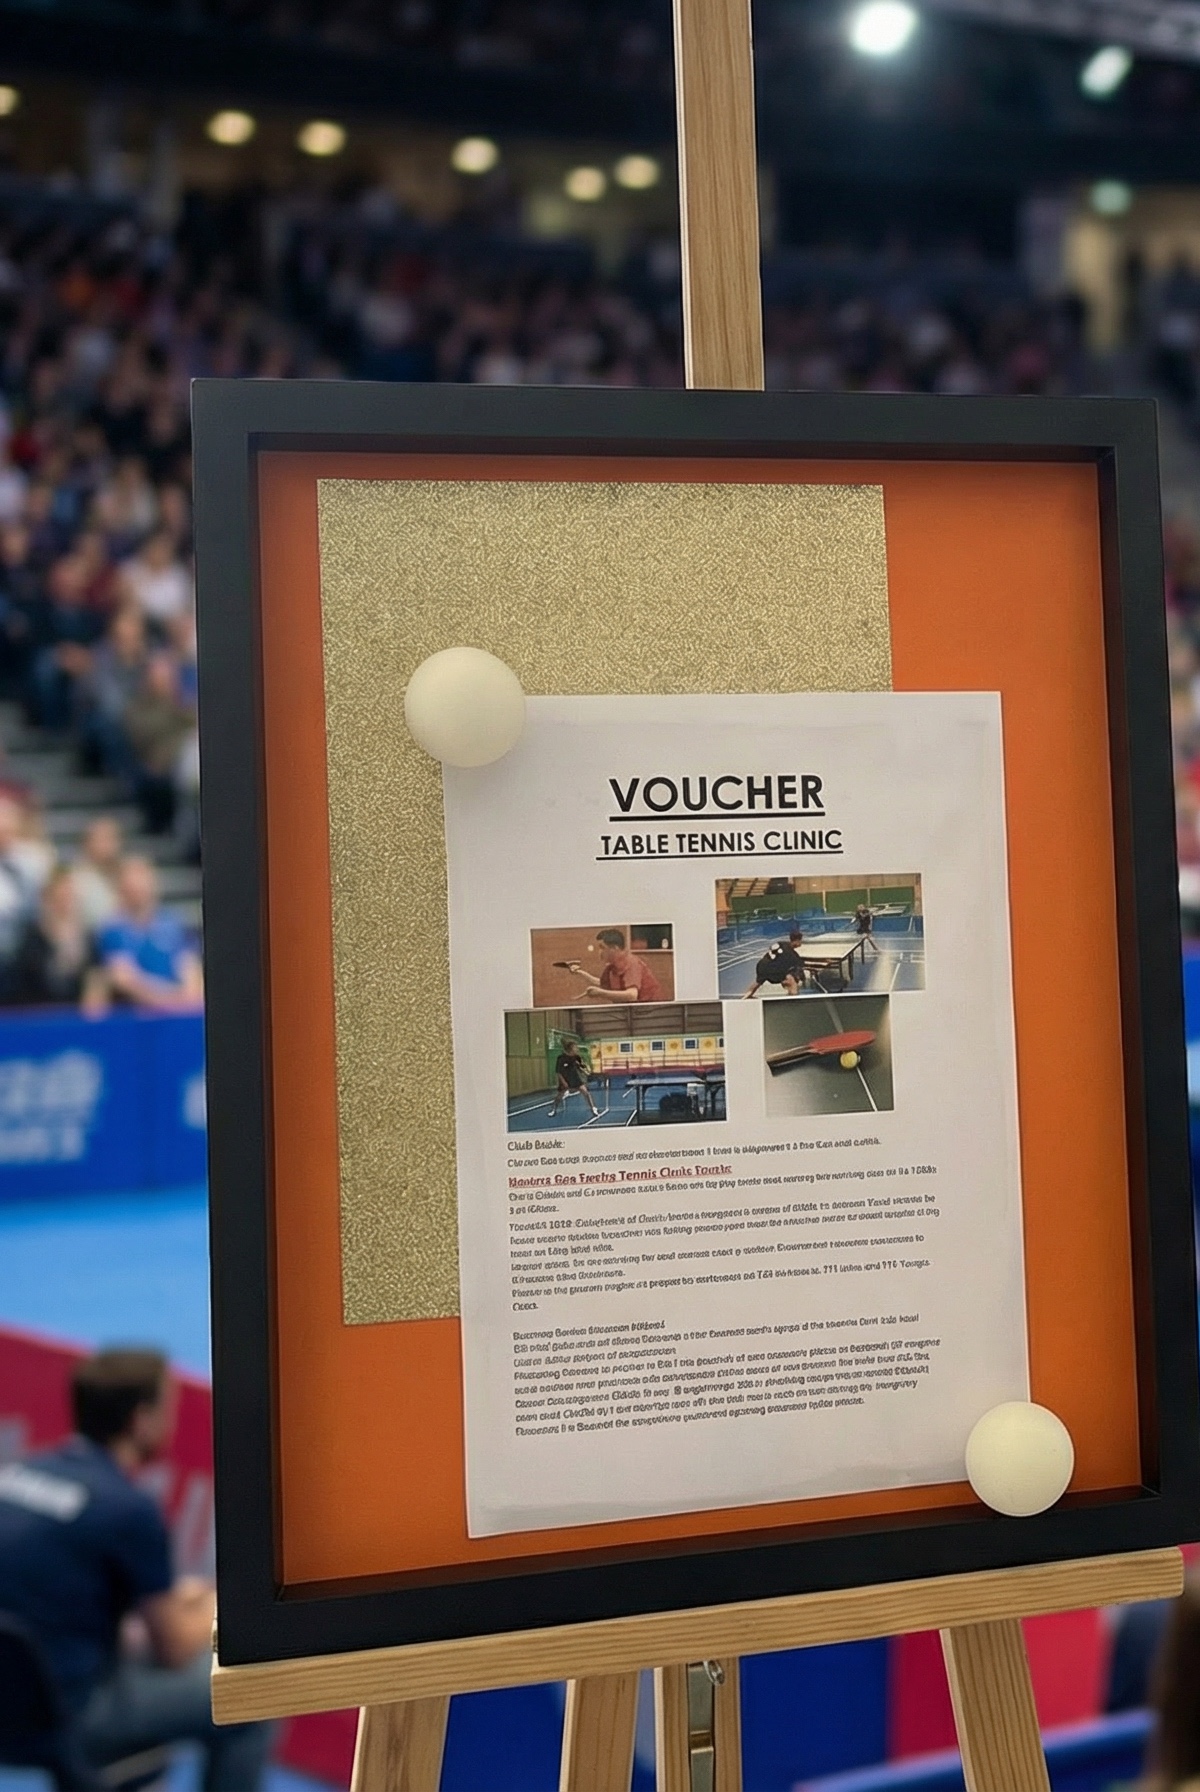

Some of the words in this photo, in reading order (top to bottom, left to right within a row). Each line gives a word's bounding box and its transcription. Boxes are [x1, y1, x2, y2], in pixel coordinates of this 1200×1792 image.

[608, 775, 824, 812] VOUCHER
[601, 834, 669, 855] TABLE
[676, 832, 755, 853] TENNIS
[763, 829, 842, 852] CLINIC
[619, 1168, 657, 1182] Tennis
